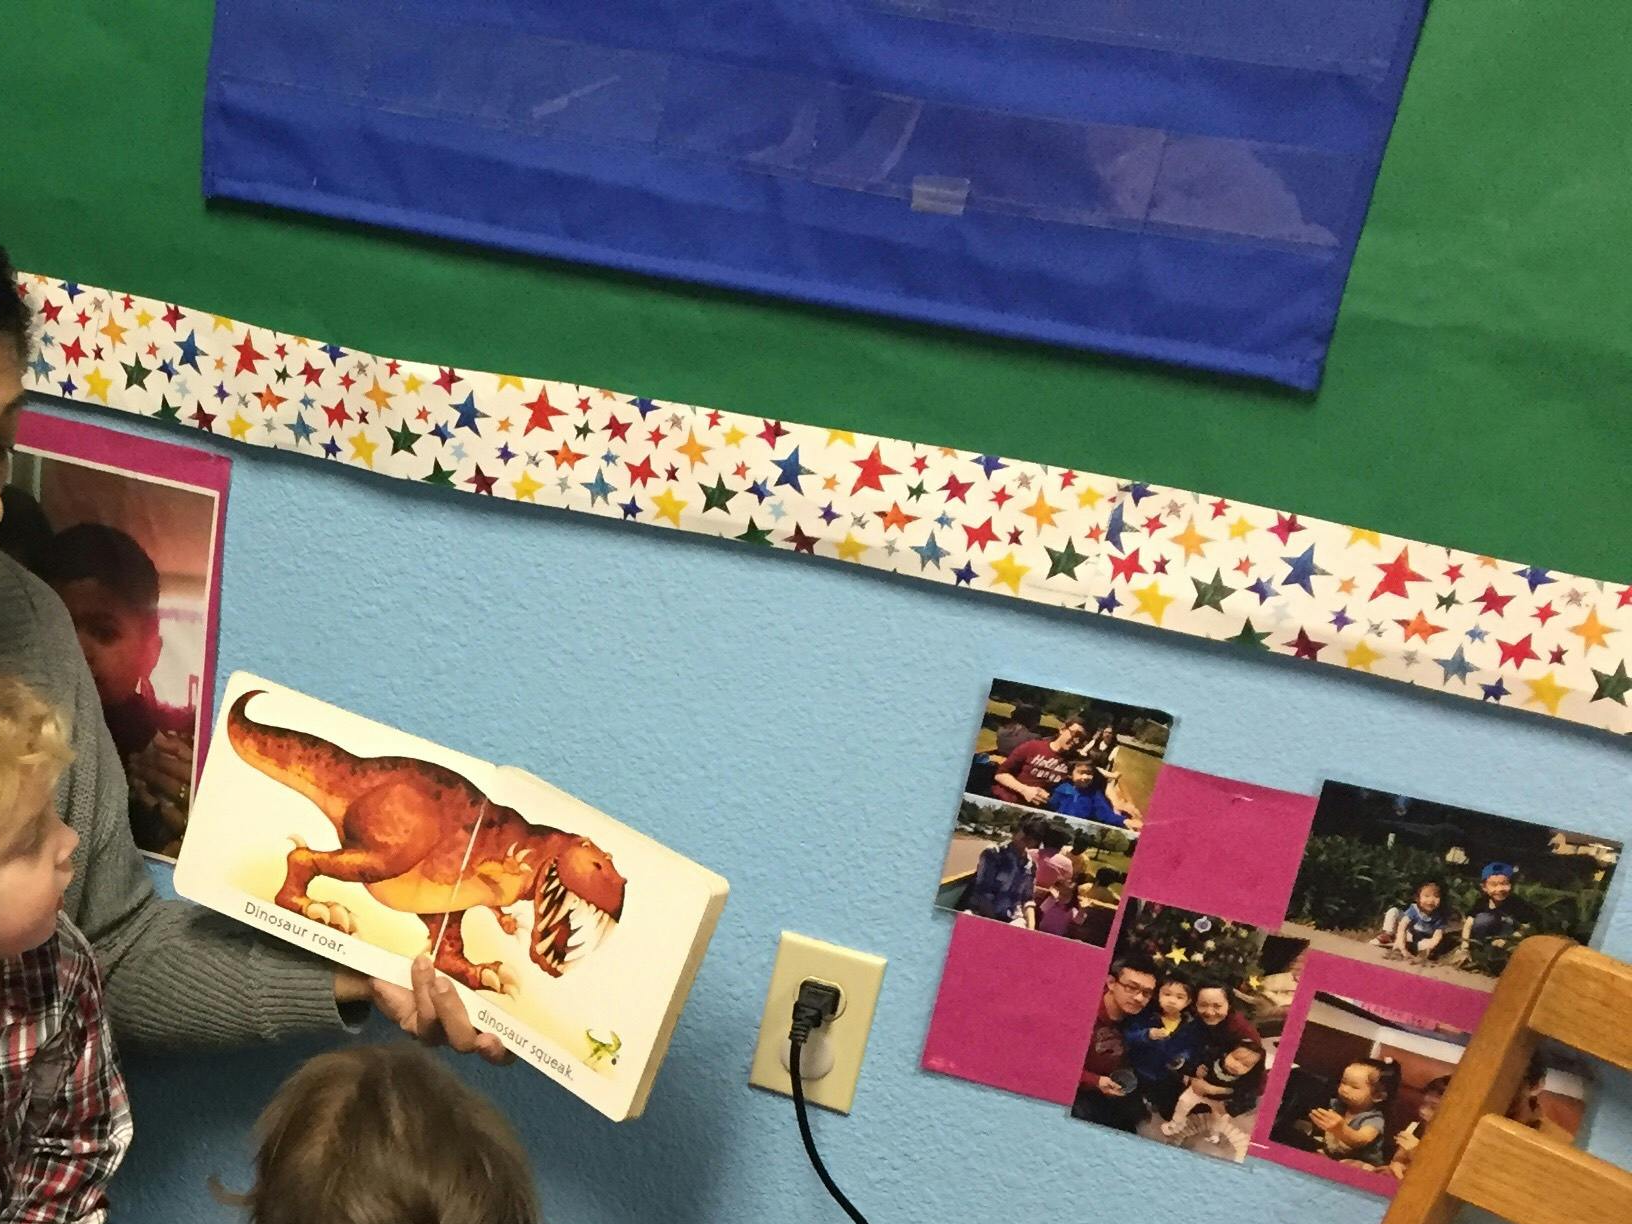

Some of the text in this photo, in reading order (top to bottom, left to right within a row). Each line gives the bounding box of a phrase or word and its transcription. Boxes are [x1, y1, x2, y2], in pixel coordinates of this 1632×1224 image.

[244, 901, 347, 955] Dinosaur roar.
[477, 1009, 574, 1081] dinosaur squeak.
